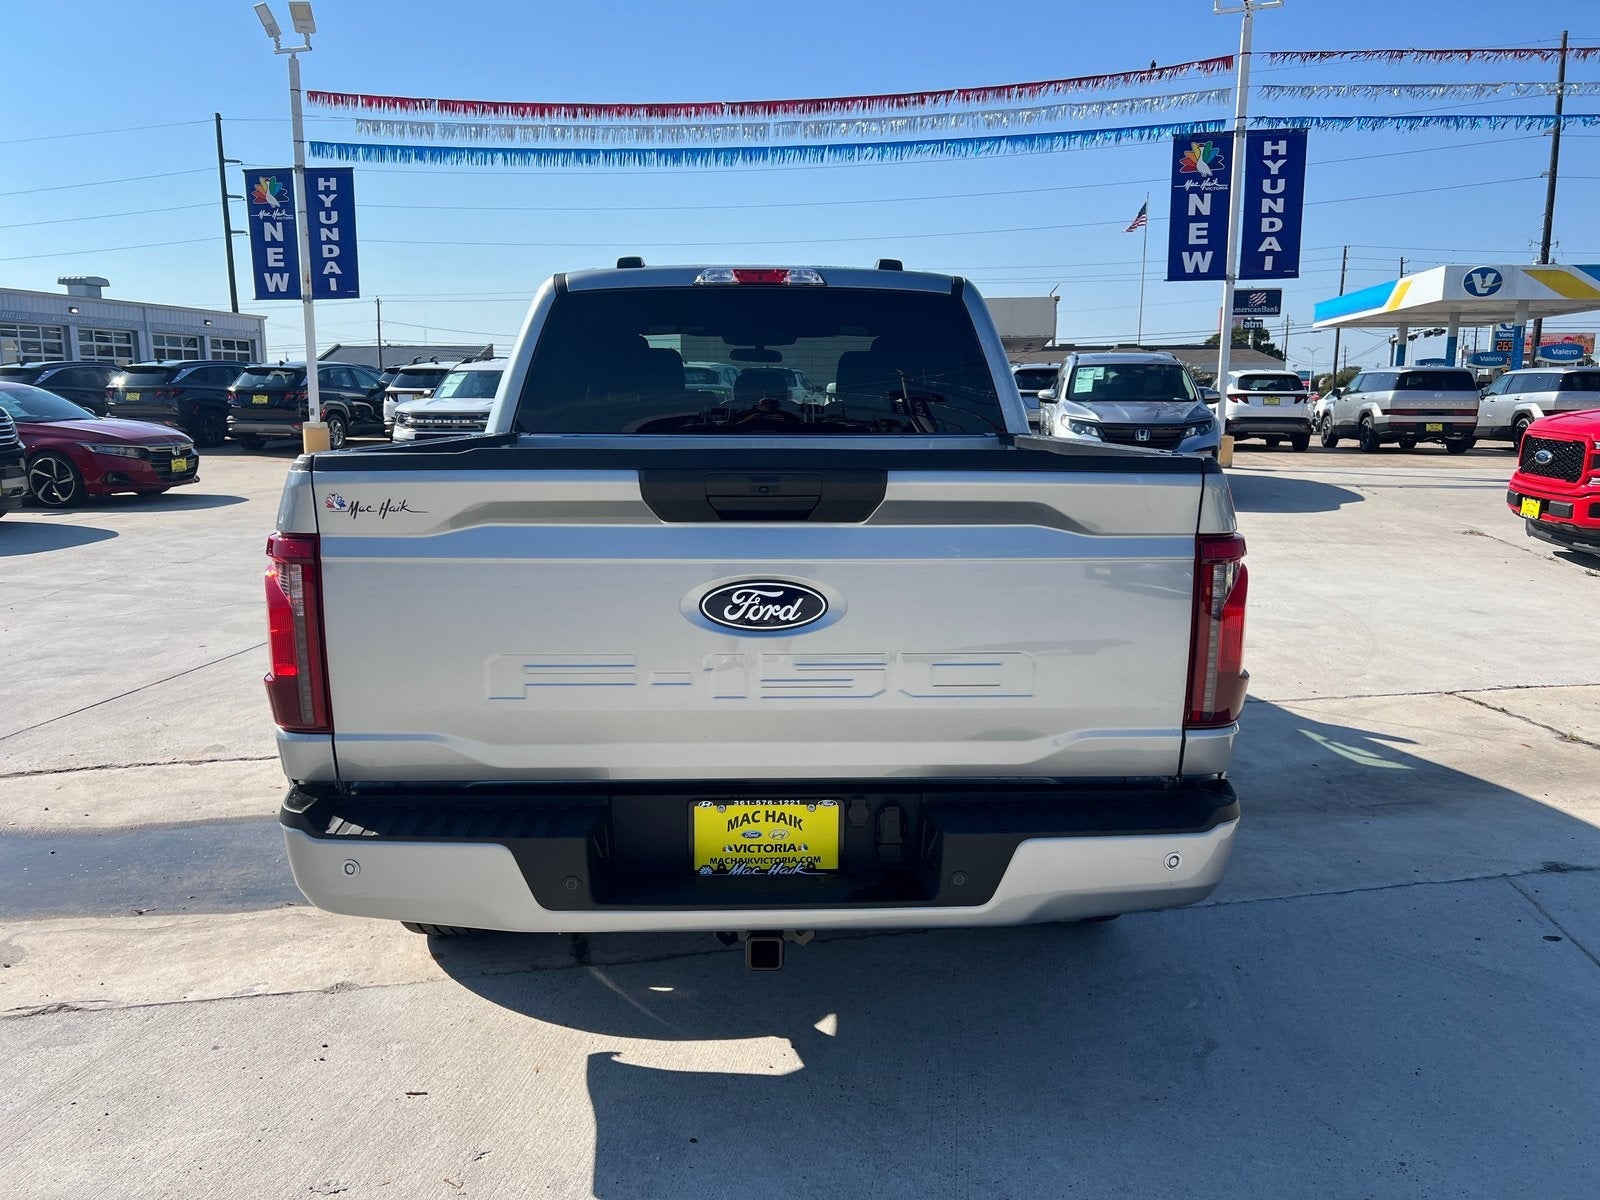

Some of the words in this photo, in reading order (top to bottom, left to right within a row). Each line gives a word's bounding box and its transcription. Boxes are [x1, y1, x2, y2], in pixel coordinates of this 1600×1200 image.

[1257, 140, 1287, 271] HYUNDAI
[317, 177, 343, 292] HYUNDAI
[1181, 192, 1214, 274] NEW
[263, 221, 290, 293] NEW
[1243, 320, 1263, 328] atm
[1479, 355, 1503, 363] Valero
[1551, 348, 1579, 356] Valero
[347, 501, 376, 519] Mac
[378, 498, 418, 519] Haik
[723, 588, 804, 621] Ford
[483, 650, 1037, 700] F-150
[727, 810, 761, 833] MAC
[764, 809, 804, 832] HAIK
[733, 844, 798, 853] VICTORIA
[709, 855, 822, 865] MACHAIKVICTORIA.COM
[727, 862, 763, 876] Mac
[766, 862, 812, 875] Haik
